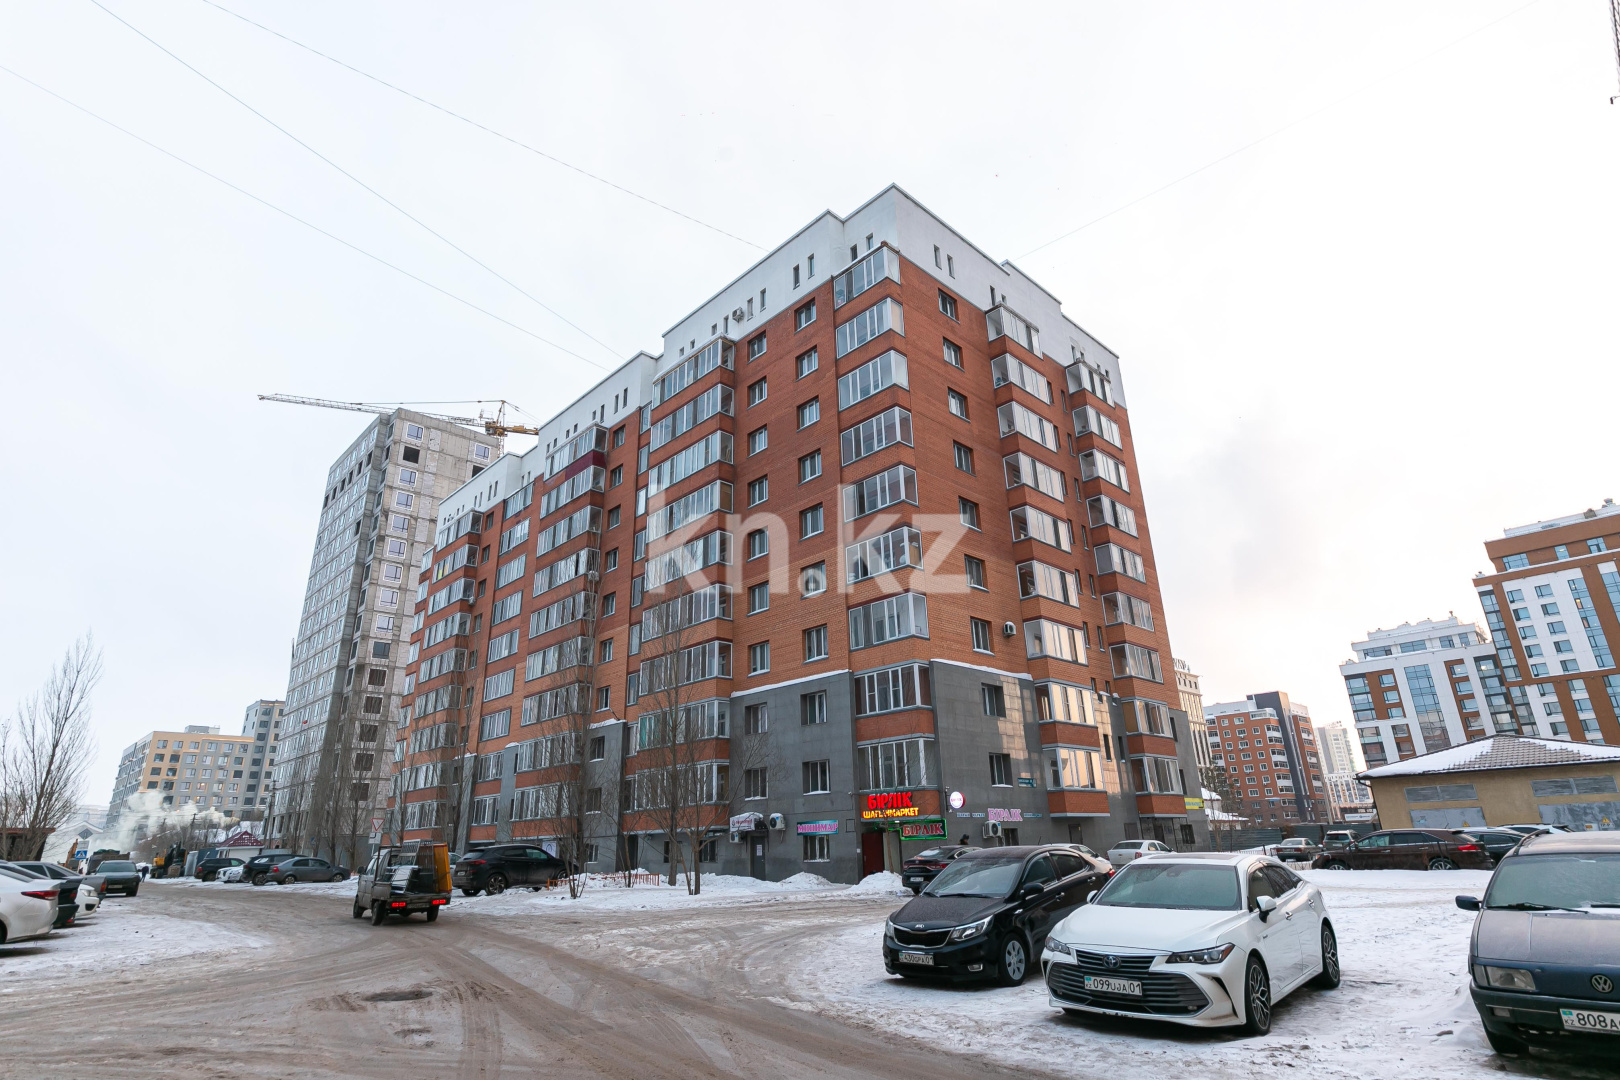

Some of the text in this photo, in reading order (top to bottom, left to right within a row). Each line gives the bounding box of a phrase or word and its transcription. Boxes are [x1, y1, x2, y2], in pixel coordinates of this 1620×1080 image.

[868, 791, 912, 810] БІРЛІК
[902, 823, 944, 836] БІРЛІК
[1576, 1012, 1620, 1030] 808A
